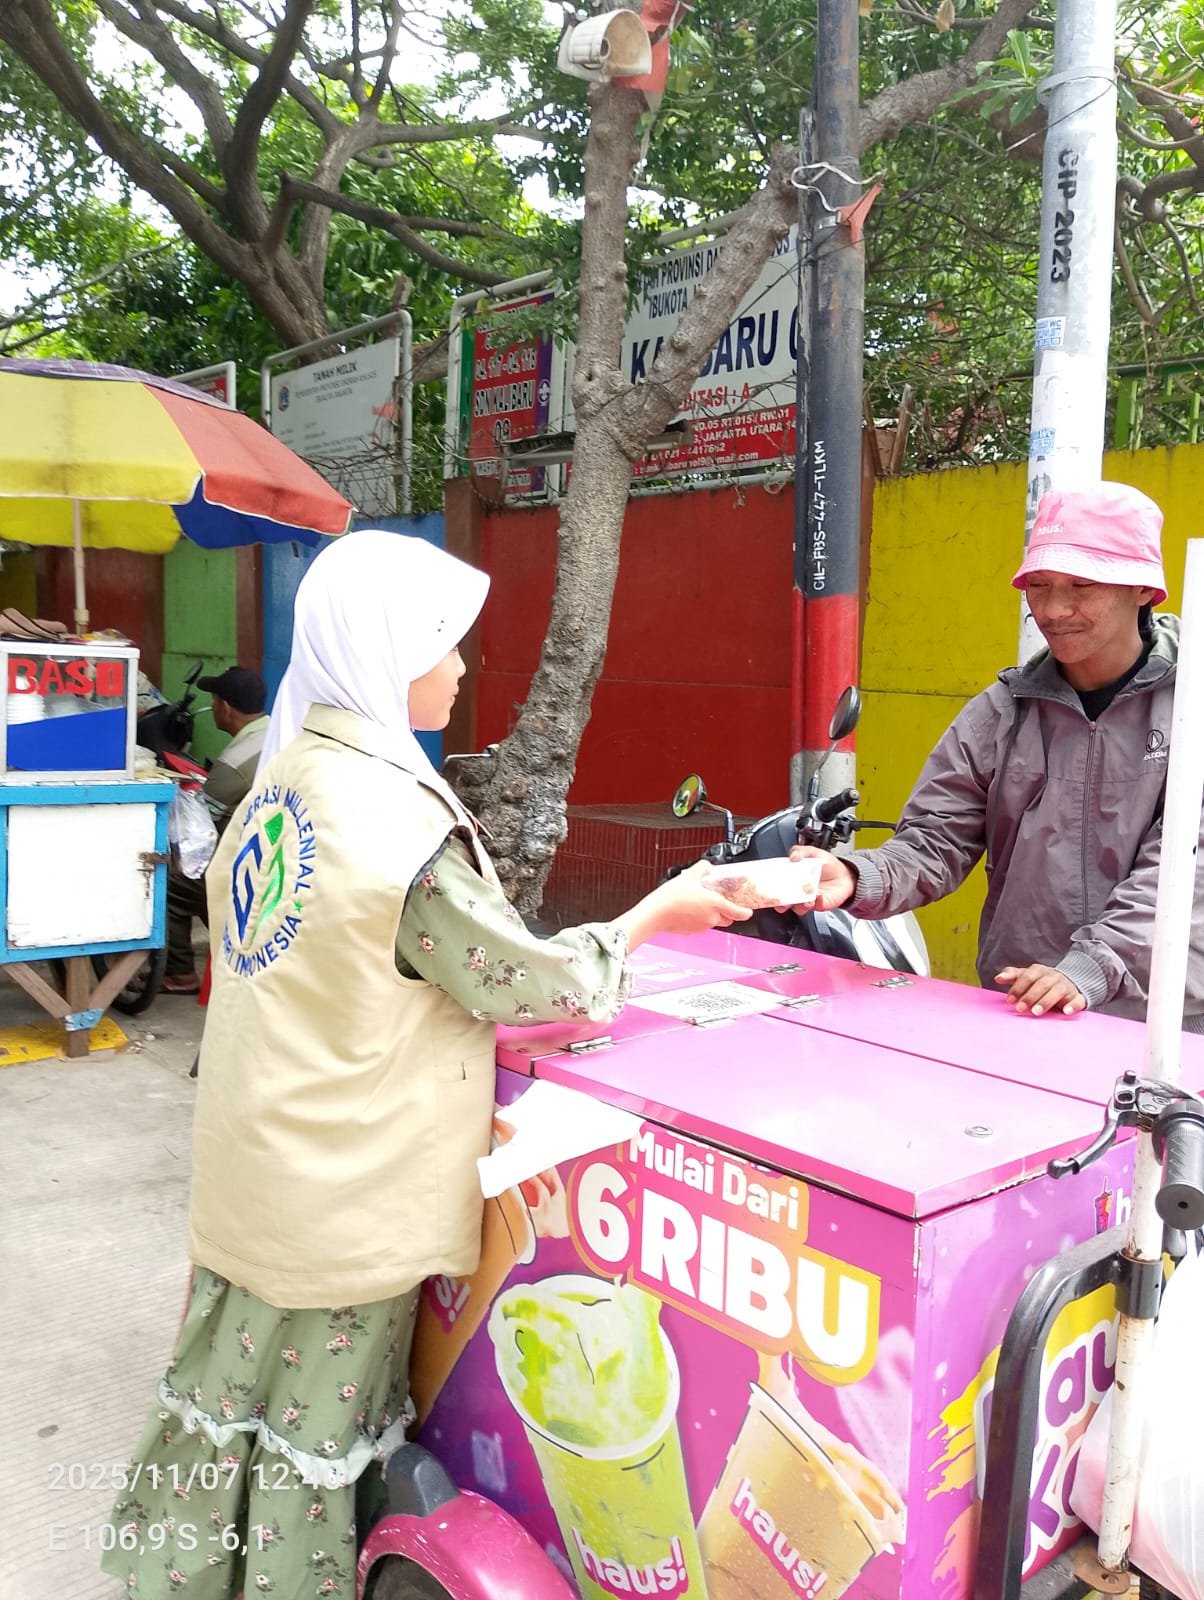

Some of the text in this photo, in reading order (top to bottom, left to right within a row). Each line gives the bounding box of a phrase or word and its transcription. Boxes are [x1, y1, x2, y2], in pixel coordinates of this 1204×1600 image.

[661, 251, 704, 288] PROVINSI
[741, 382, 751, 402] A
[494, 418, 511, 447] 09
[703, 428, 748, 442] JAKARTA
[750, 422, 783, 435] UTARA
[8, 657, 124, 697] BASO
[283, 787, 317, 895] MILLENIAL
[630, 1131, 715, 1195] Mulai
[722, 1162, 799, 1231] Dari
[577, 1162, 870, 1368] 6 RIBU
[572, 1526, 687, 1594] haus!
[733, 1480, 829, 1600] haus!
